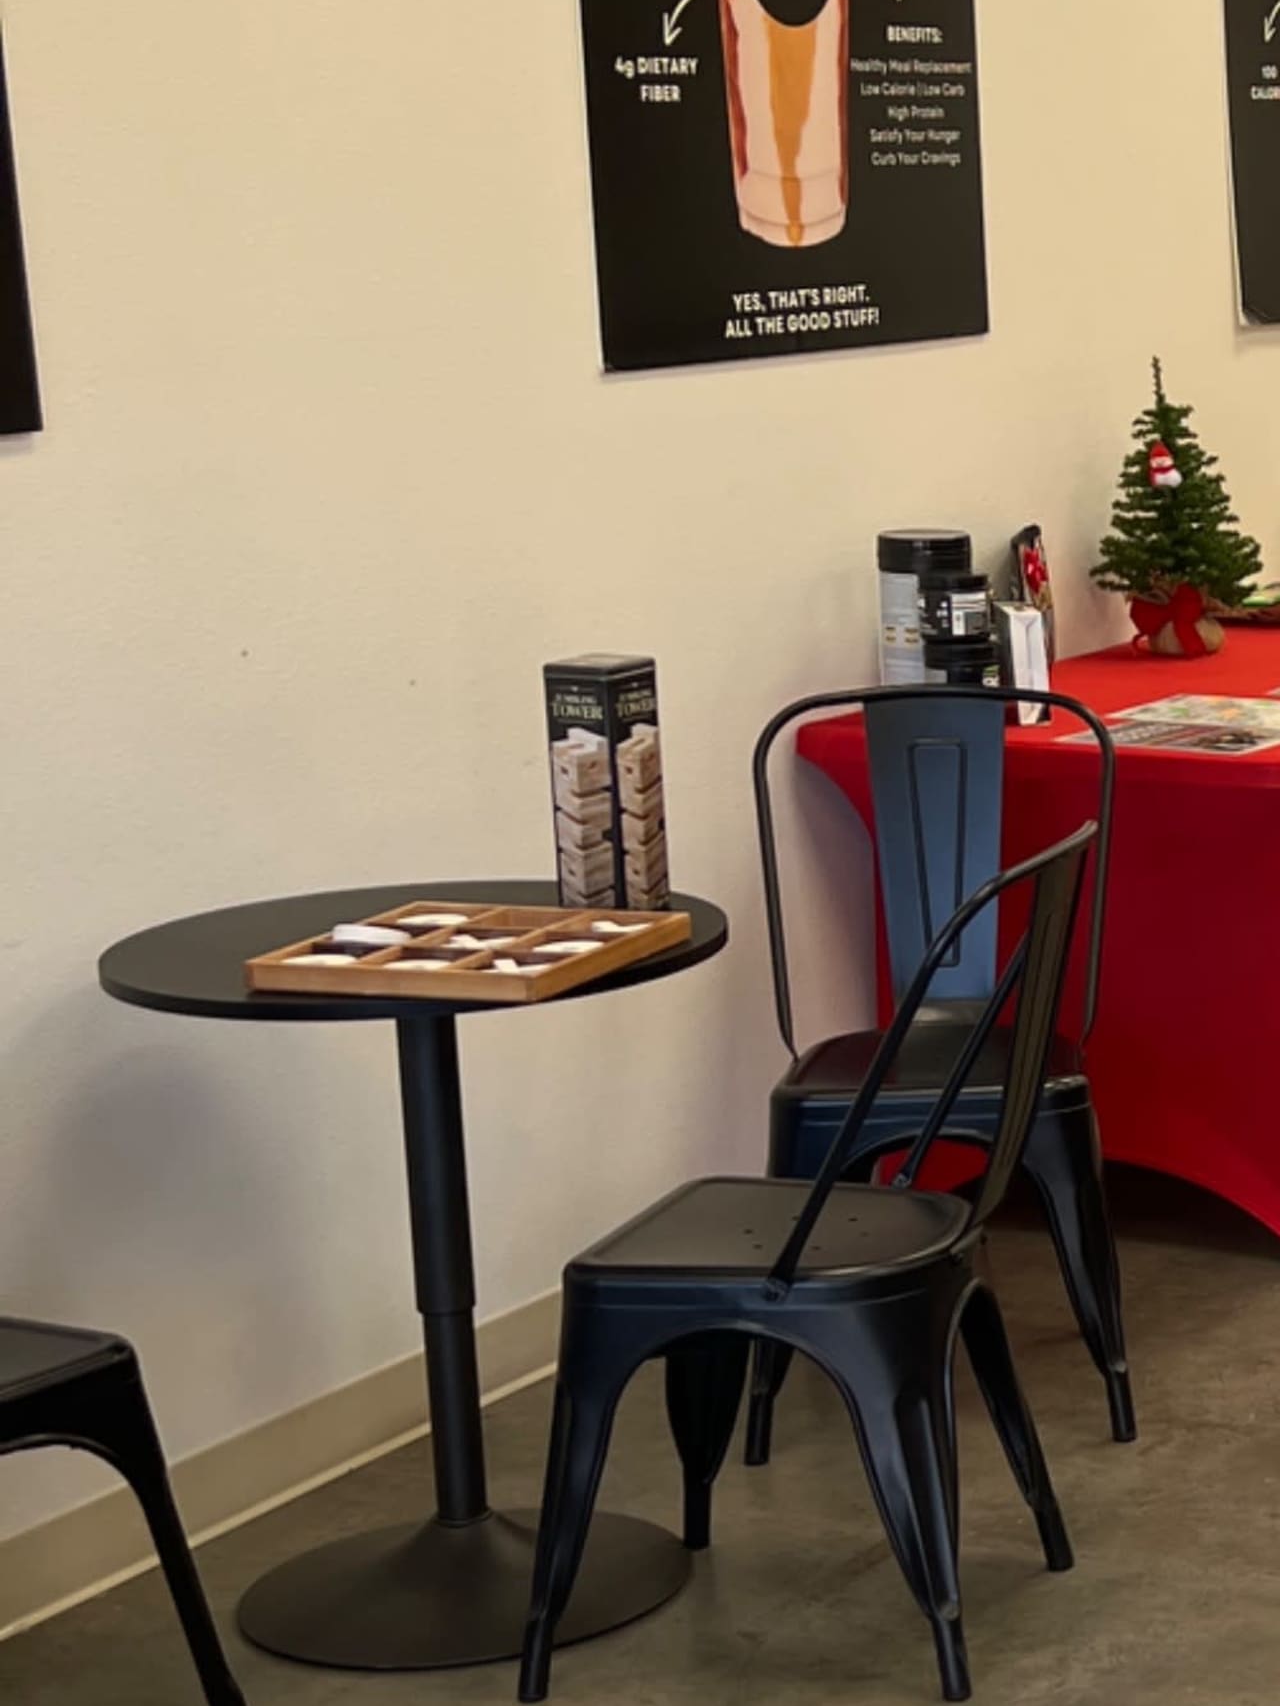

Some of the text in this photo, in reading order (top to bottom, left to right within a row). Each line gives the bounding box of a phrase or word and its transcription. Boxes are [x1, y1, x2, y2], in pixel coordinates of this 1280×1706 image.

[614, 56, 699, 79] 4g DIETARY
[641, 85, 681, 102] FIBER
[911, 104, 944, 118] Protein
[903, 127, 925, 142] Your
[733, 283, 870, 313] YES, THAT'S RIGHT.
[725, 306, 880, 339] ALL THE GOOD STUFF!
